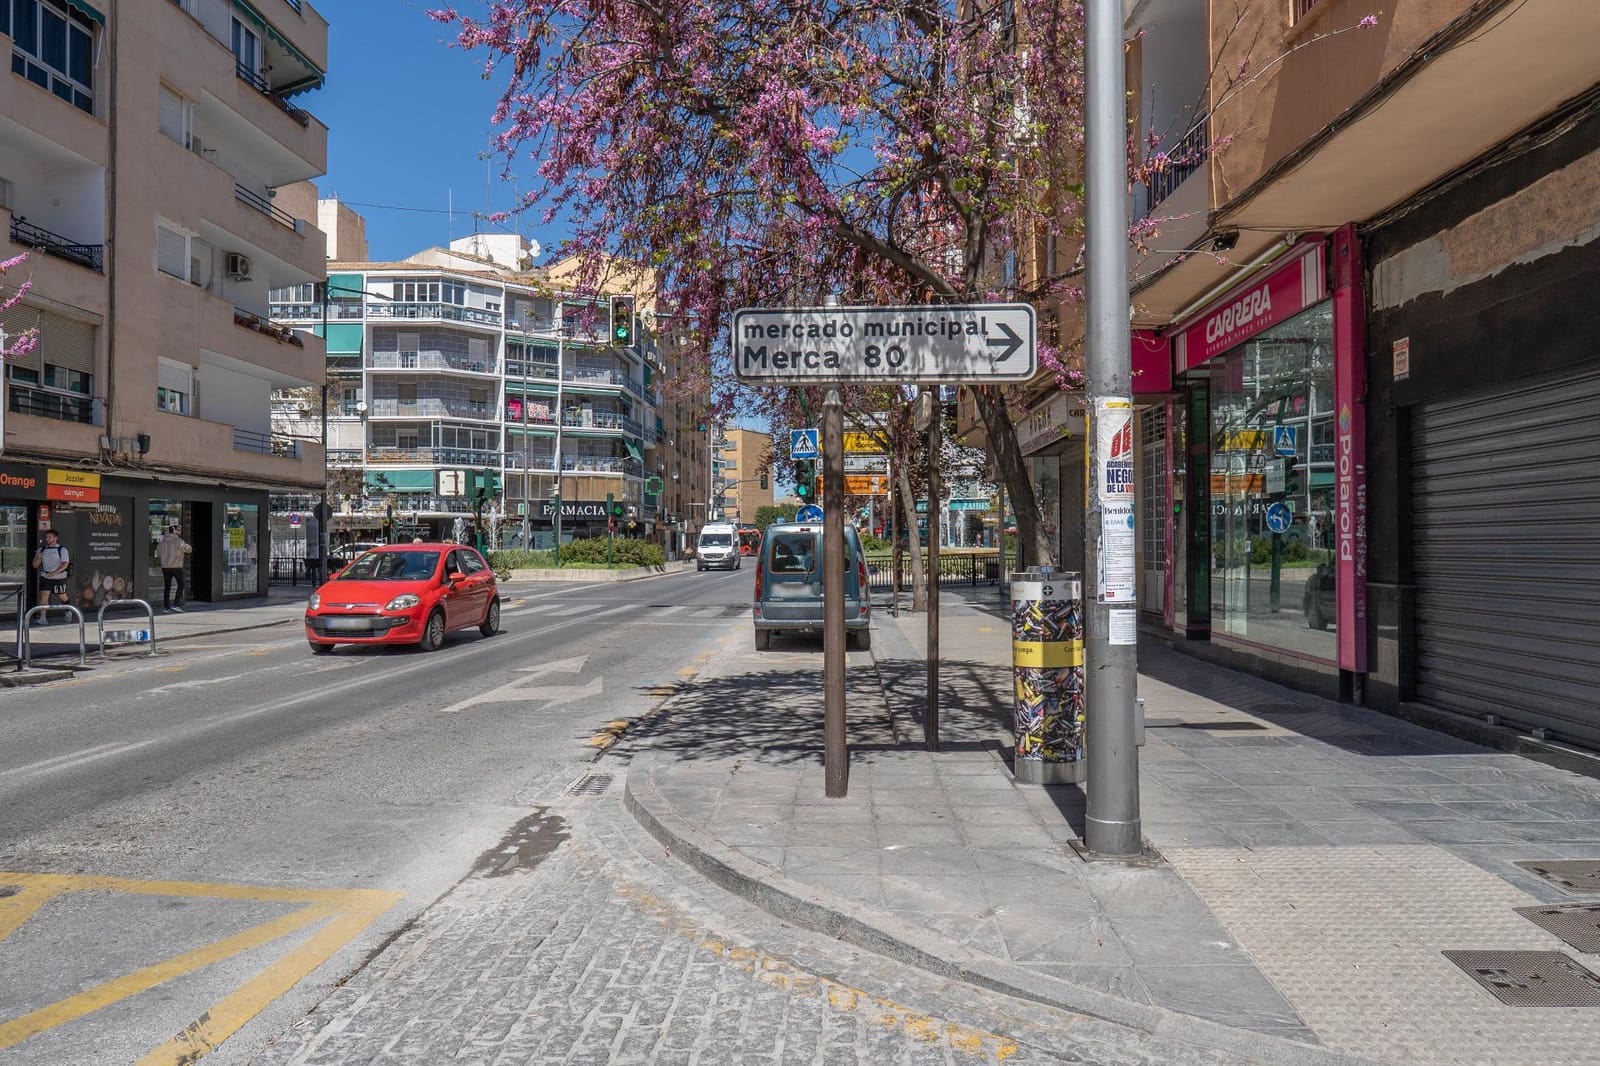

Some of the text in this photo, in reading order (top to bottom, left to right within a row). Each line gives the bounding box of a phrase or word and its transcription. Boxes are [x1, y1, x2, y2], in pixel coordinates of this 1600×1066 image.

[1206, 284, 1271, 343] CARRERA
[744, 317, 988, 340] mercado municipal
[744, 345, 905, 369] Merca 80
[0, 474, 35, 488] Orange
[1107, 484, 1116, 493] DE
[1117, 484, 1124, 493] LA
[64, 489, 84, 498] simyo
[1339, 435, 1353, 561] Polaroid
[88, 511, 121, 526] NEVADA
